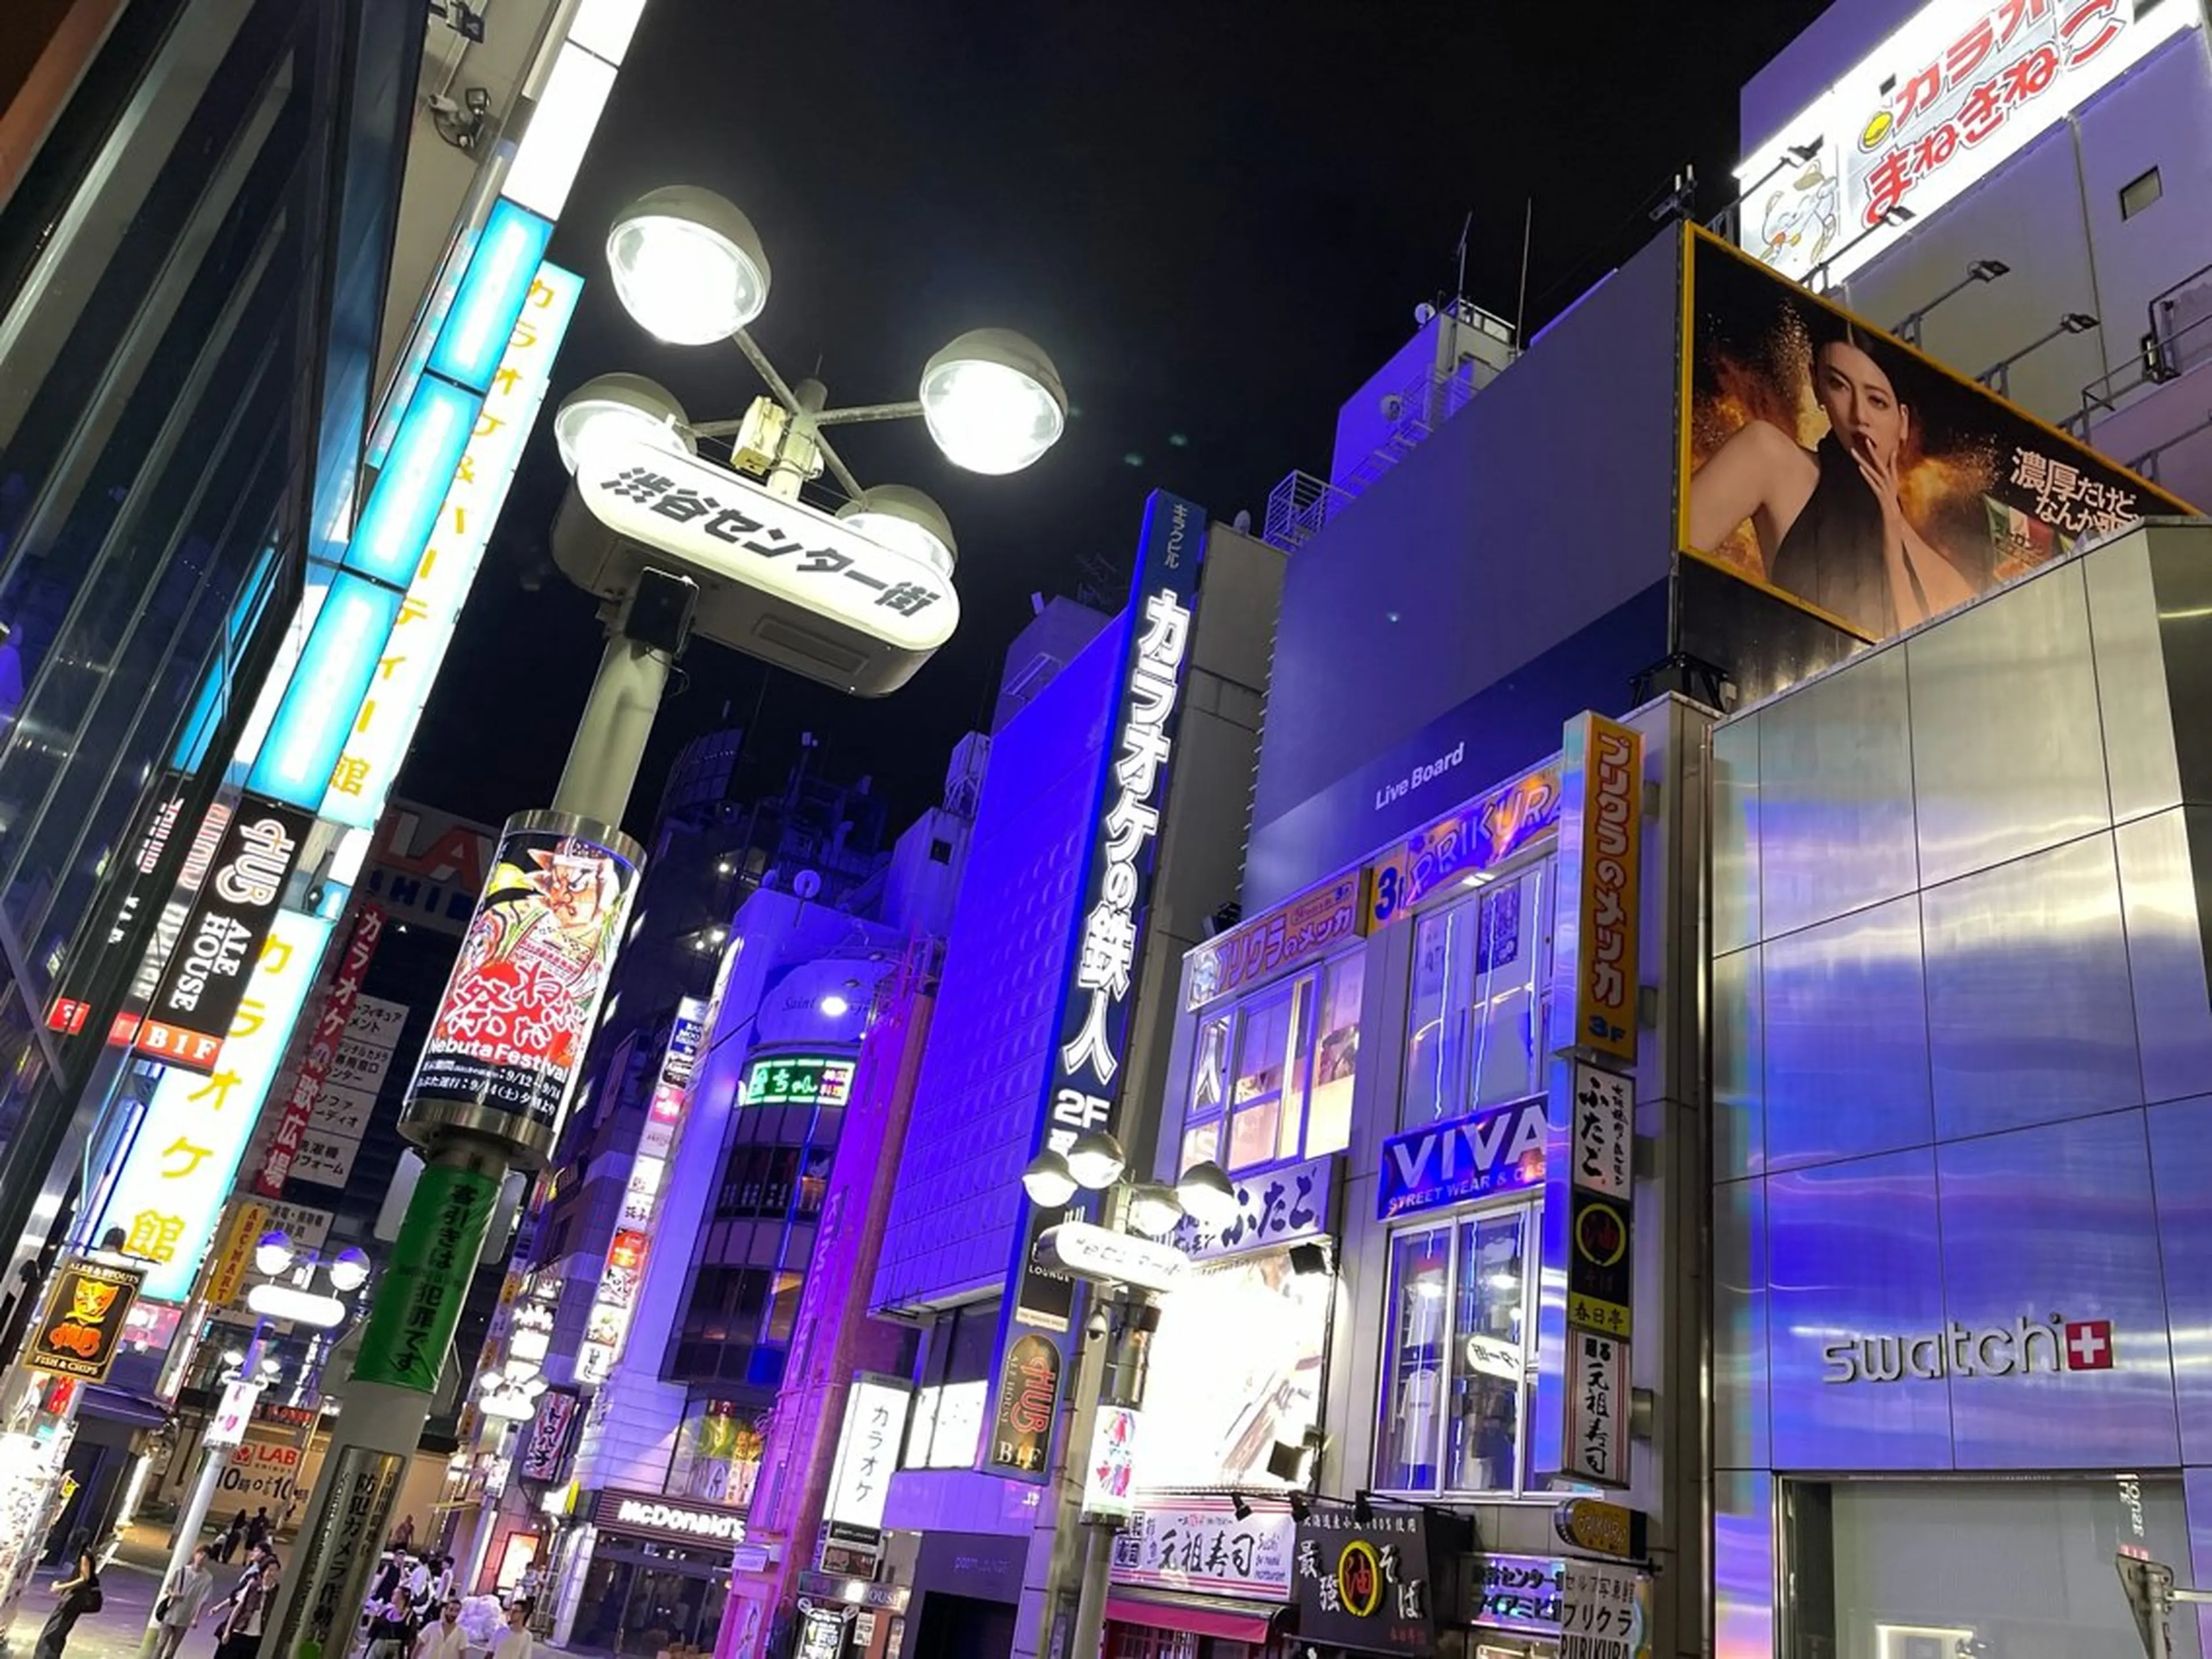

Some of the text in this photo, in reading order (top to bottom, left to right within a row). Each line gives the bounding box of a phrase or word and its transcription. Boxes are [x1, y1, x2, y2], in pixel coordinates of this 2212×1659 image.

[1862, 0, 2126, 229] まねきねこ
[601, 467, 941, 616] 渋谷センター街
[1374, 741, 1465, 810] Live Board
[216, 818, 298, 907] HUB
[1063, 588, 1190, 1085] カラオケの鉄人
[1591, 732, 1631, 1009] プリクラのメッカ
[169, 912, 229, 1012] HOUSE
[213, 918, 252, 977] ALE
[429, 1037, 567, 1083] Nebuta Festival
[1054, 1088, 1111, 1129] 2F
[1393, 1104, 1547, 1189] VIVA
[1578, 1075, 1609, 1177] ふたご
[1221, 1166, 1317, 1247] ふたご
[1388, 1187, 1443, 1210] STREET
[1446, 1175, 1490, 1197] WEAR
[1574, 1300, 1624, 1332] 春日亭
[1823, 1316, 2061, 1384] swatch
[1010, 1356, 1056, 1433] HUB
[1585, 1362, 1610, 1475] 元祖寿司
[856, 1404, 889, 1502] カラオケ
[618, 1499, 746, 1543] McDonald's
[1158, 1528, 1255, 1577] 元祖寿司
